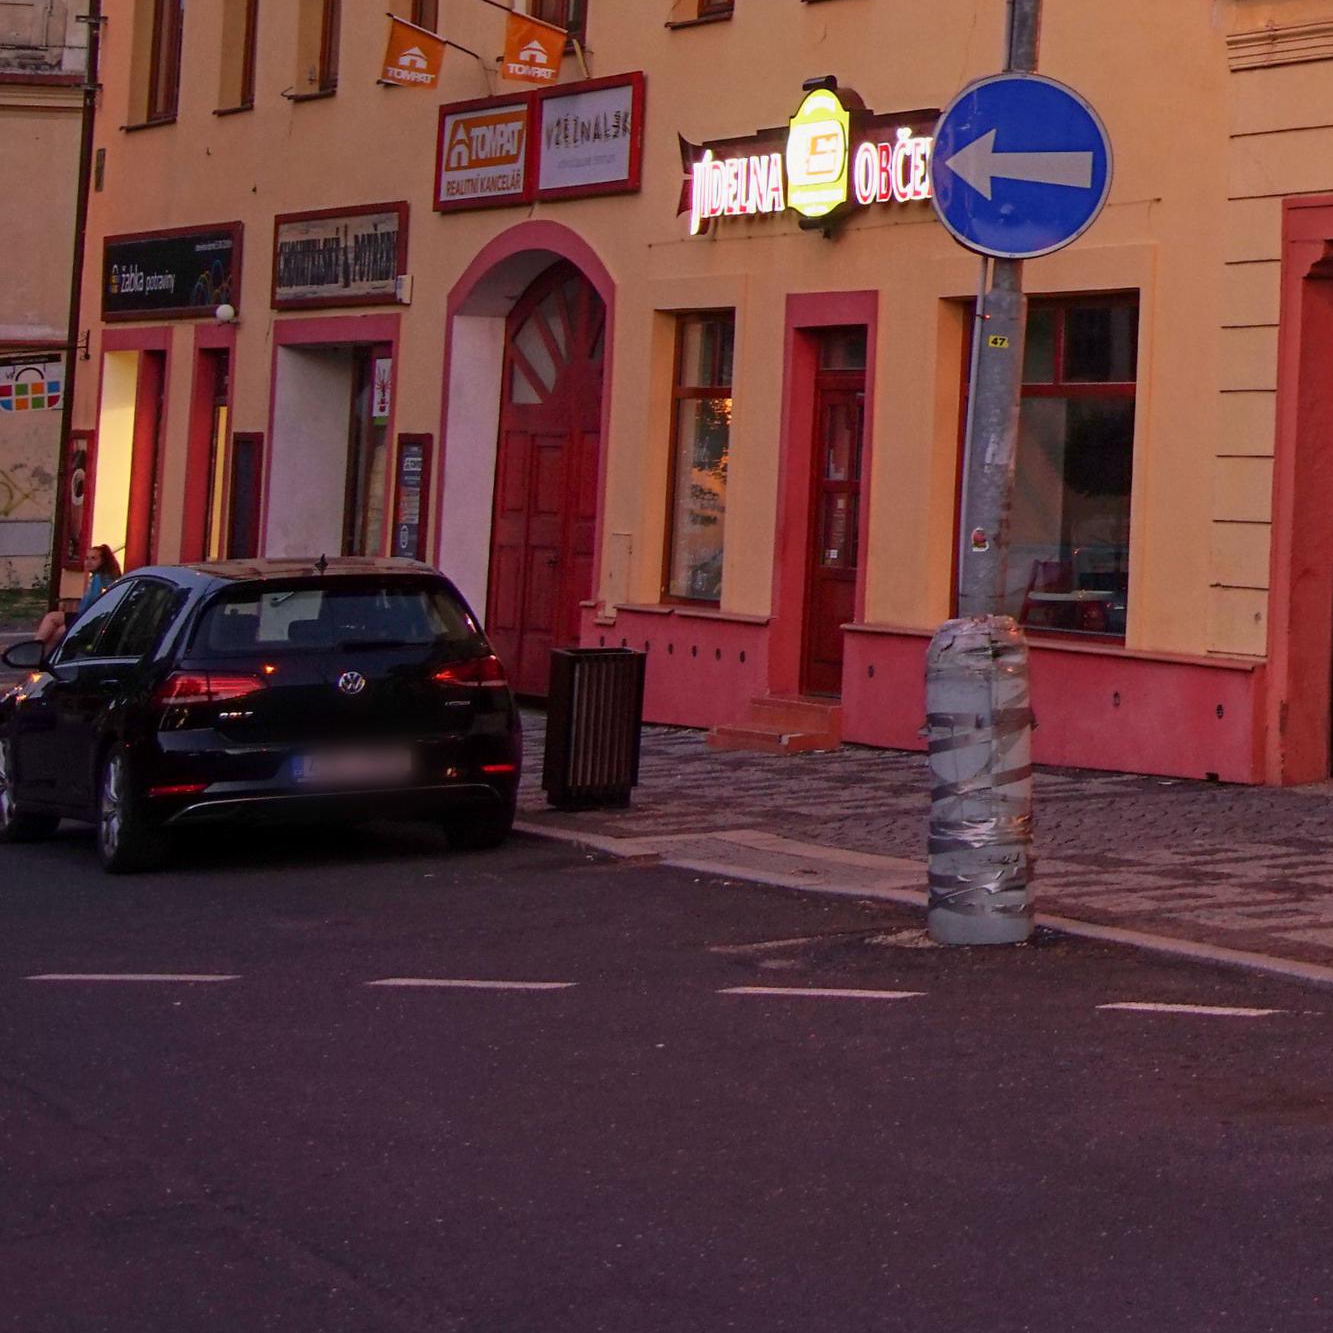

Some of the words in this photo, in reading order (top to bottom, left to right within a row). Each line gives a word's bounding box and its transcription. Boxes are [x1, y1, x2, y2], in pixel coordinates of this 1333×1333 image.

[387, 67, 436, 84] TOMPAT
[508, 63, 555, 79] TOMPAT
[470, 121, 524, 161] TOMPAT
[690, 149, 785, 235] JÍDELNA
[855, 127, 934, 205] OBČE
[121, 265, 144, 293] žabka
[145, 269, 176, 295] potraviny
[991, 337, 1006, 346] 47
